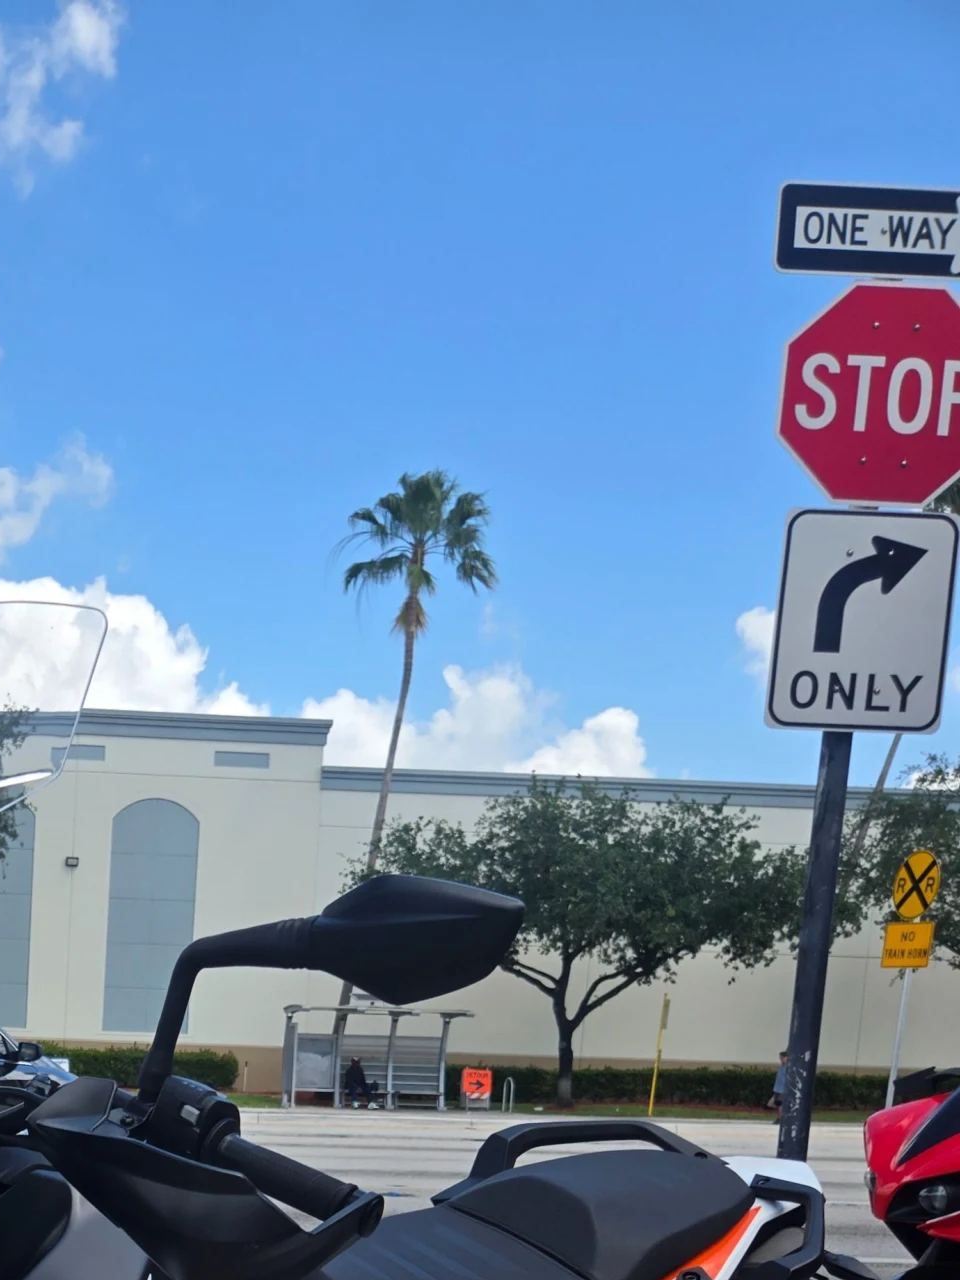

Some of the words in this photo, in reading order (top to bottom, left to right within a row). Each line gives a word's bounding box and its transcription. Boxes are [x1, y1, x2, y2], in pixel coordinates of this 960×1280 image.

[803, 211, 869, 246] ONE
[888, 215, 956, 250] WAY
[790, 670, 924, 713] ONLY
[900, 931, 915, 942] NO
[885, 948, 905, 959] TRAIN
[907, 948, 927, 959] HORN
